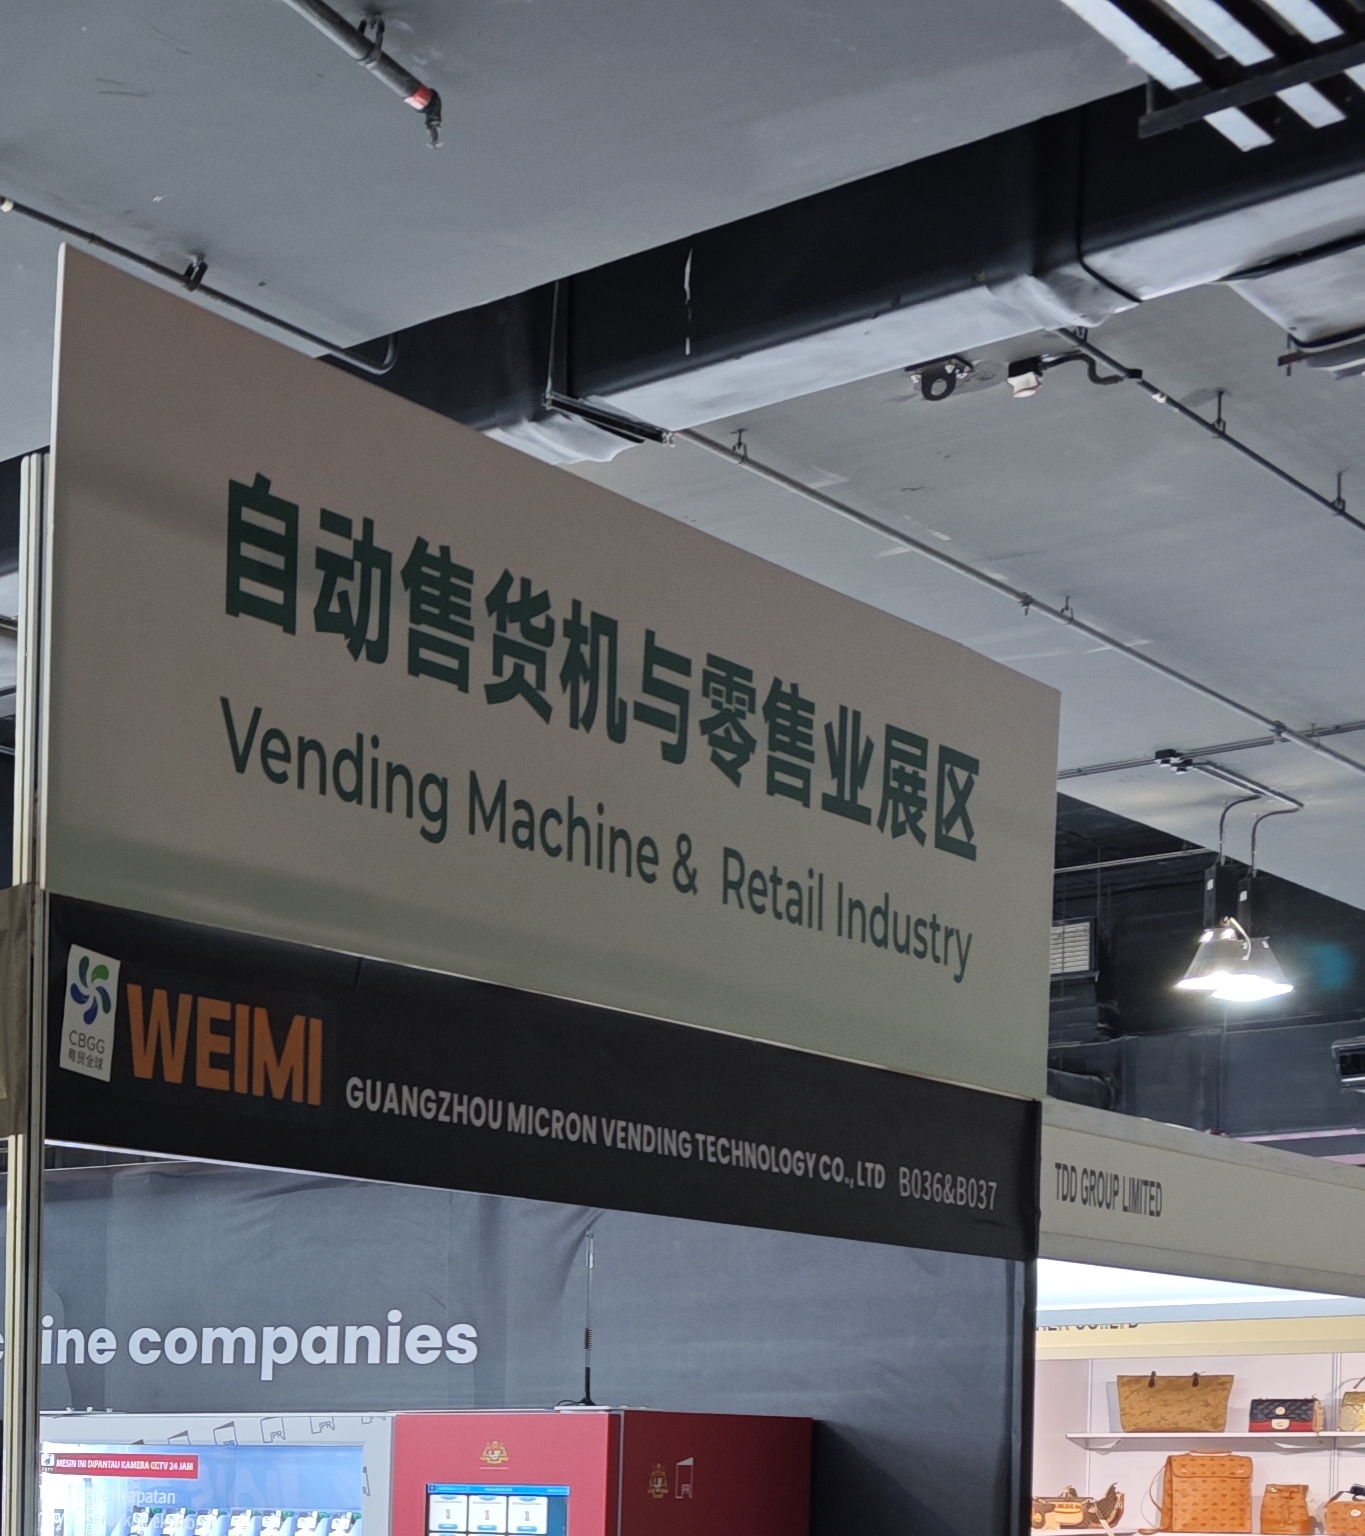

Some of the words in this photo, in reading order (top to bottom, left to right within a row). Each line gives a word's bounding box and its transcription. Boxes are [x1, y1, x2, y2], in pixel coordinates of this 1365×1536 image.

[225, 471, 980, 862] 自动售货机与零售业展区
[219, 696, 450, 844] Vending
[468, 769, 660, 884] Machine
[672, 833, 699, 896] &
[722, 846, 824, 933] Retail
[836, 881, 973, 984] Industry
[69, 1029, 106, 1055] CBGG
[126, 982, 324, 1106] WEIMI
[345, 1076, 503, 1130] GUANGZHOU
[507, 1102, 598, 1145] MICRON
[600, 1117, 693, 1158] VENDING
[694, 1133, 817, 1179] TECHNOLOGY
[856, 1161, 886, 1190] LTD
[899, 1166, 998, 1211] B036&B037
[1054, 1161, 1078, 1204] TDD
[1079, 1168, 1119, 1212] GROUP
[1121, 1174, 1163, 1218] LIMITED
[127, 1308, 480, 1382] companies
